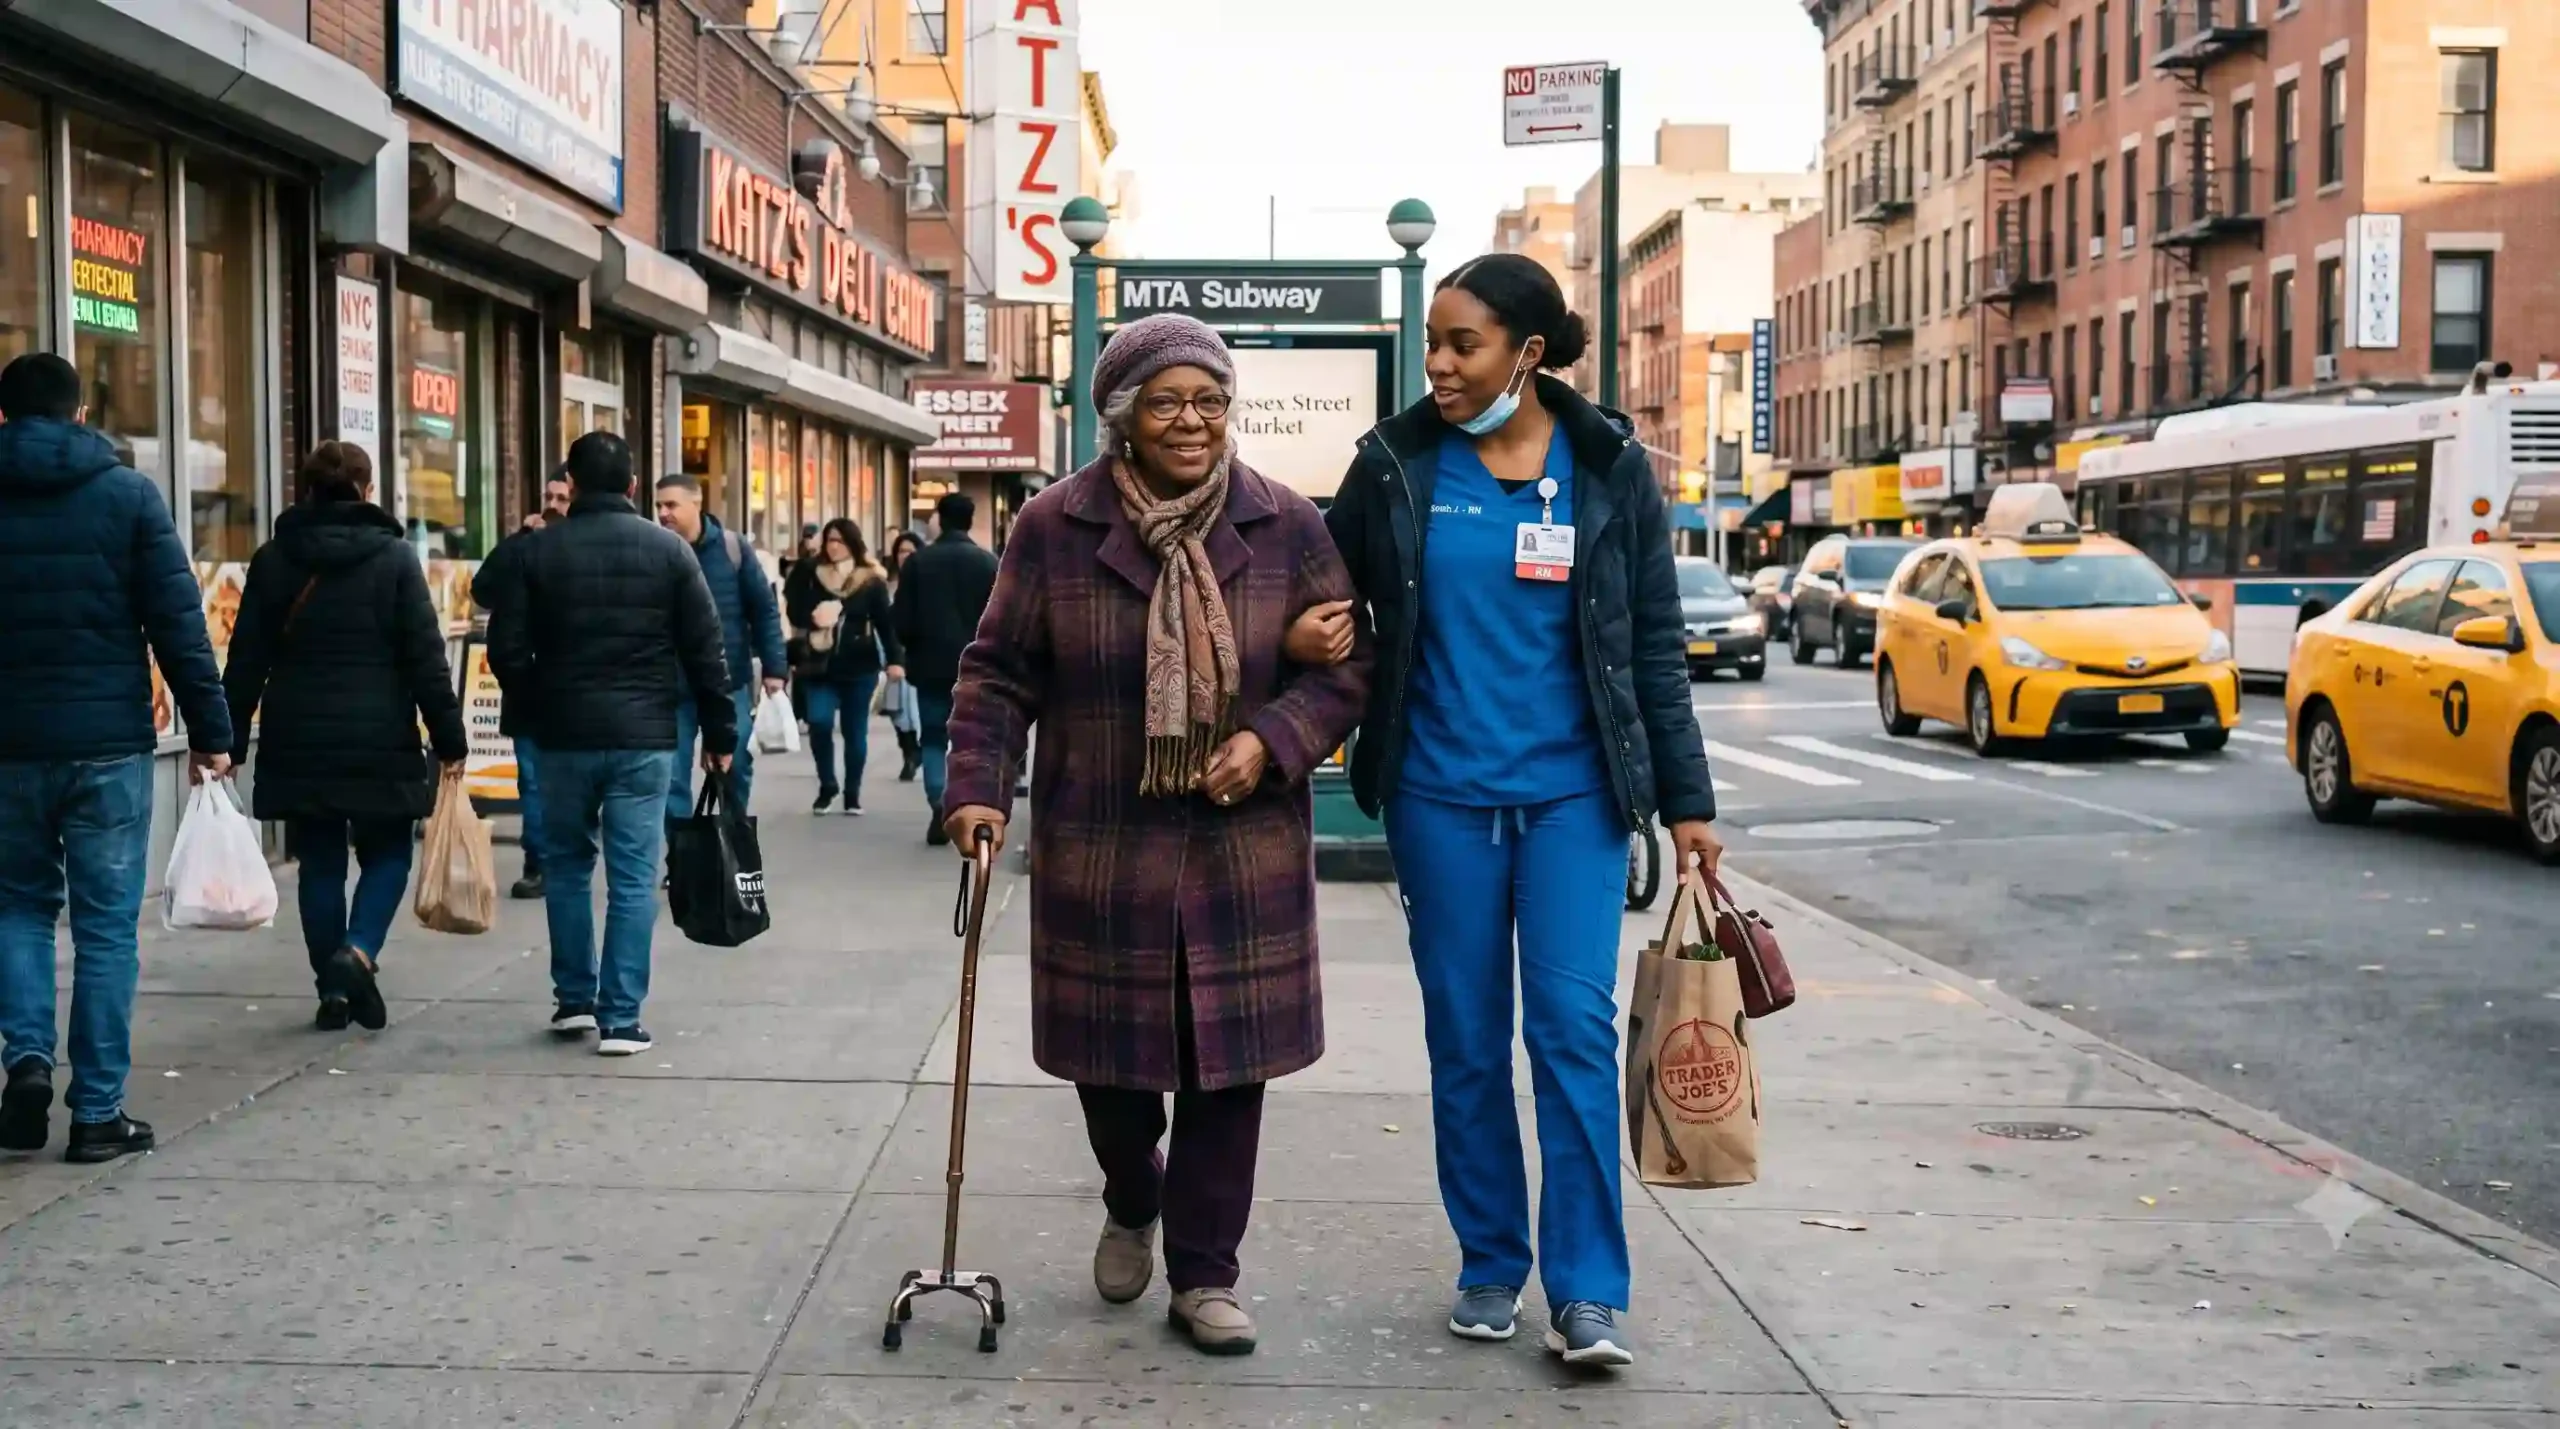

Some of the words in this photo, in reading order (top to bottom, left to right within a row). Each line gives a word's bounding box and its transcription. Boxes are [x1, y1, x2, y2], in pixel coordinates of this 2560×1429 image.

[1507, 70, 1533, 94] NO
[1540, 69, 1602, 89] PARKING
[711, 147, 810, 290] KATZ'S
[1124, 281, 1190, 307] MTA
[1202, 281, 1322, 313] Subway
[341, 289, 372, 332] NYC
[413, 370, 456, 415] OPEN
[914, 389, 1009, 414] ESSEX
[1292, 395, 1352, 411] Street
[1468, 505, 1482, 514] RN
[1535, 566, 1552, 578] RN
[2449, 690, 2464, 730] T
[1665, 1060, 1736, 1085] TRADER
[1678, 1080, 1728, 1100] JOE'S
